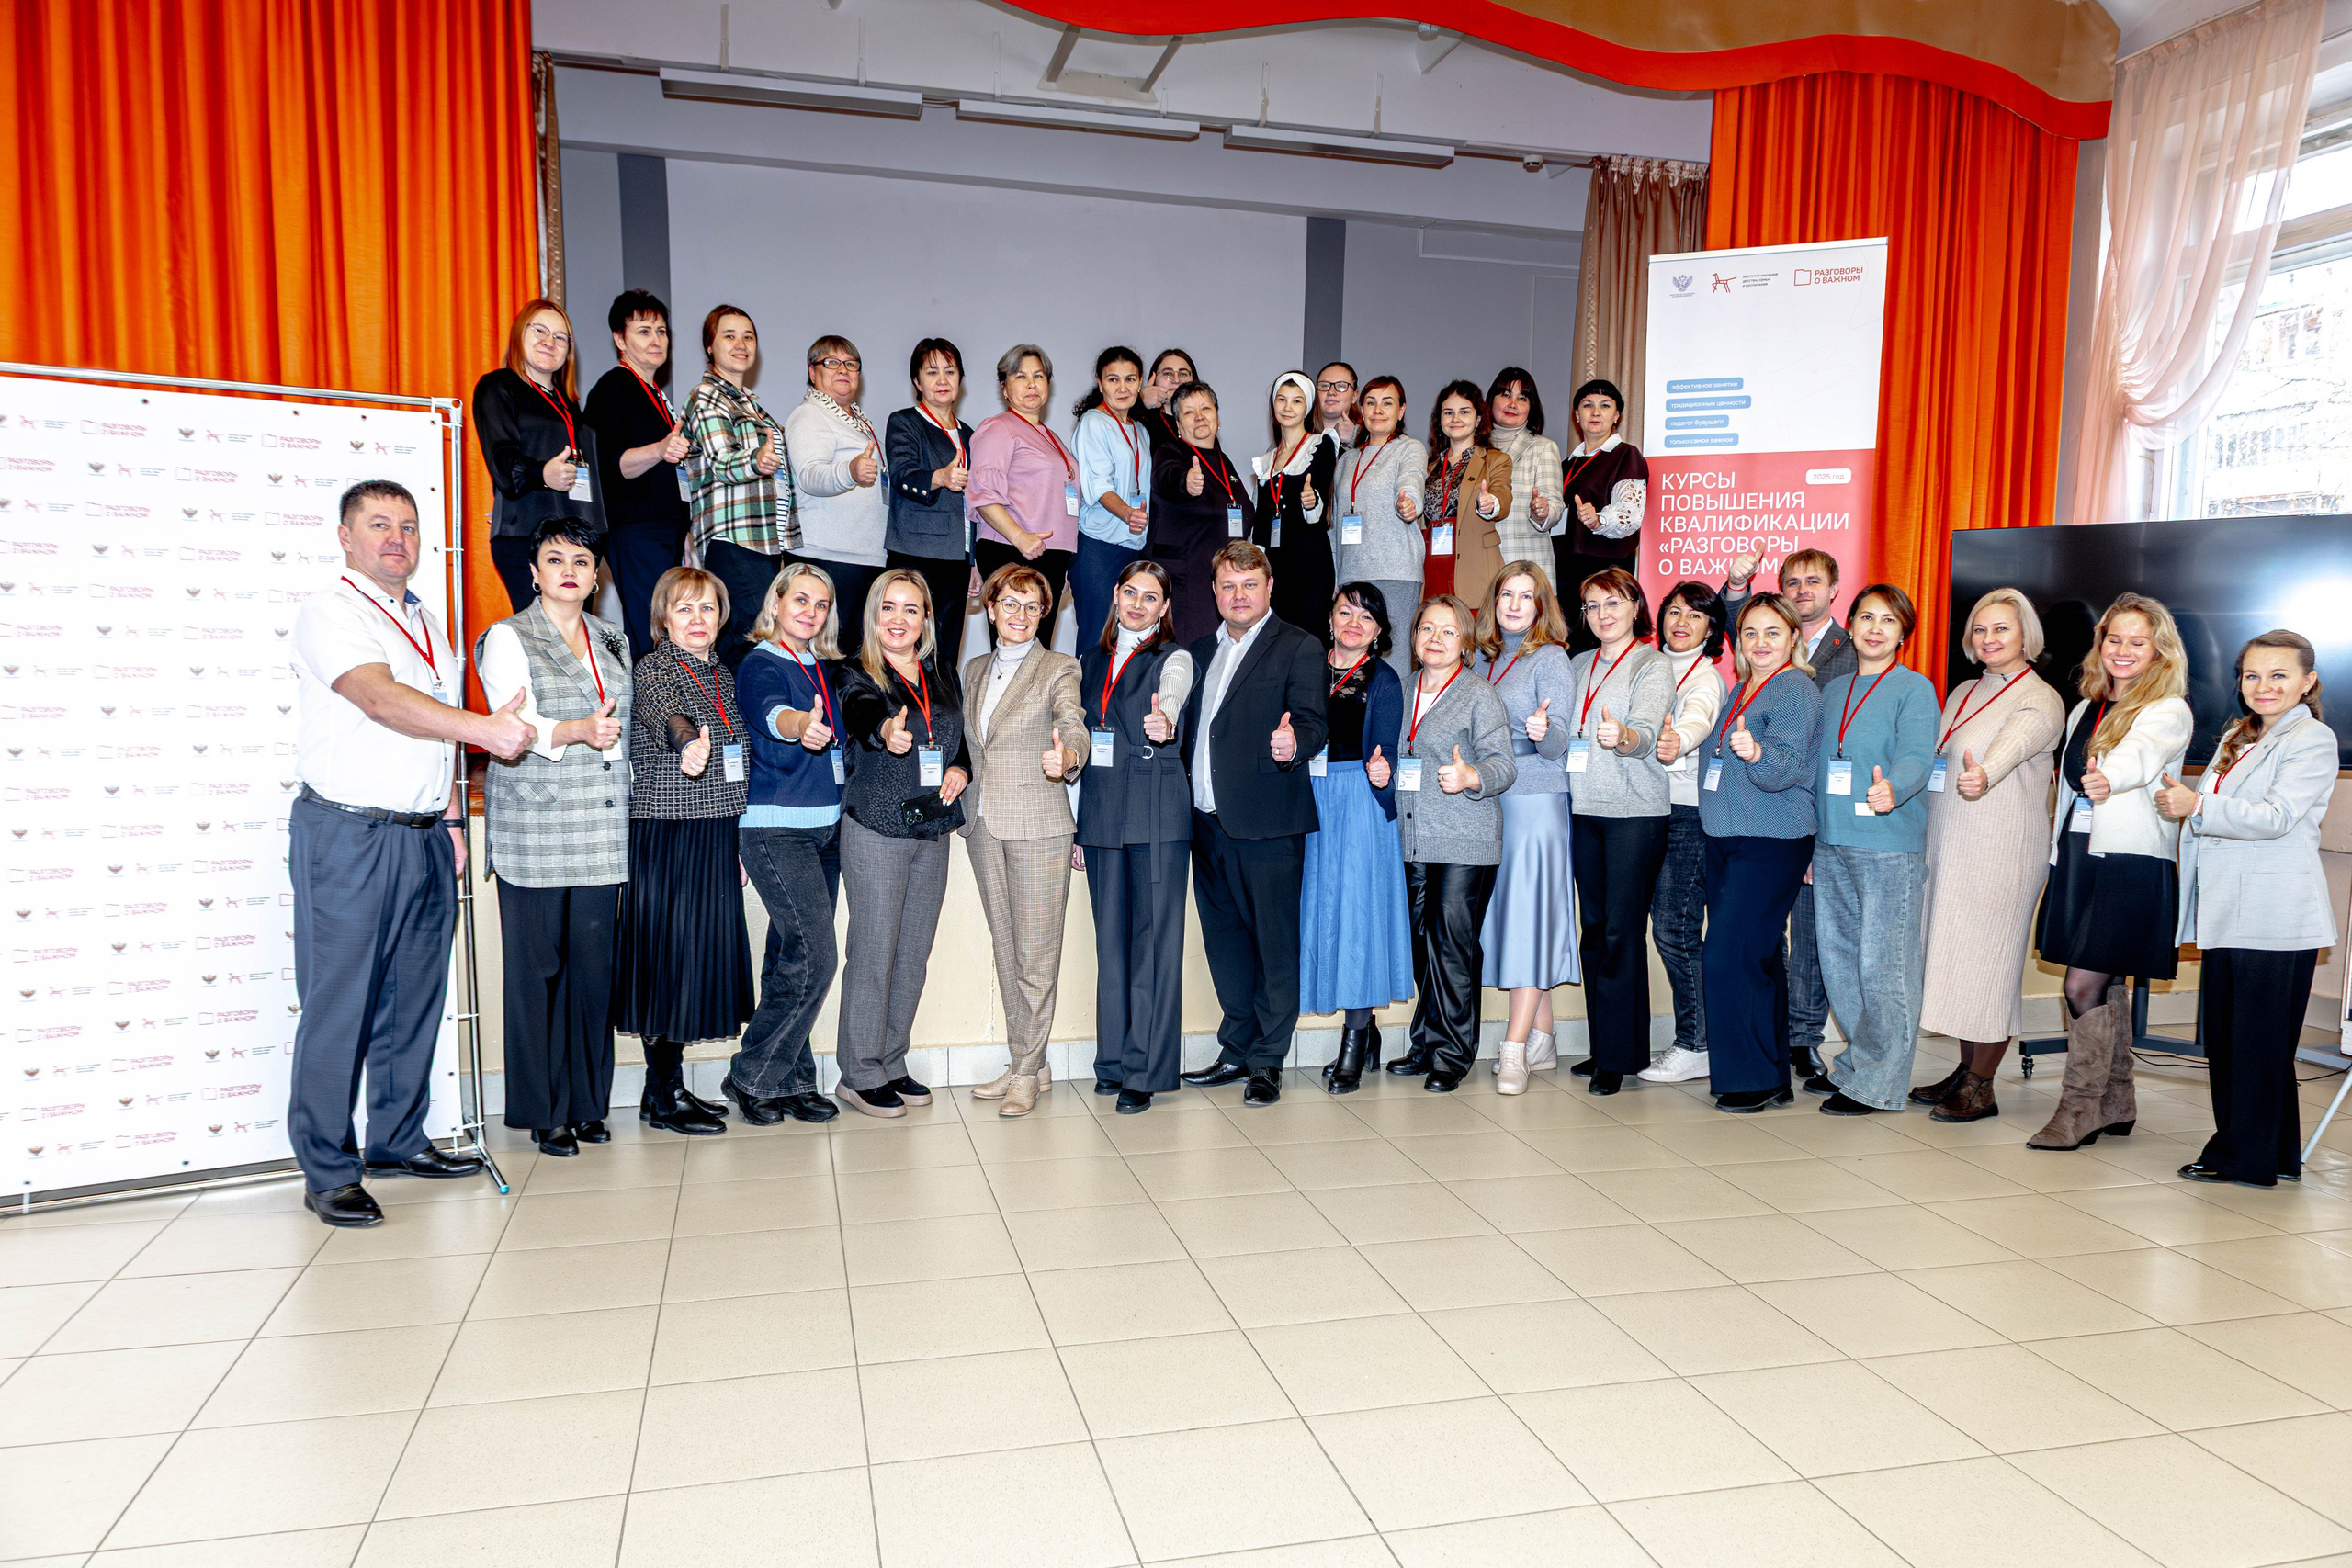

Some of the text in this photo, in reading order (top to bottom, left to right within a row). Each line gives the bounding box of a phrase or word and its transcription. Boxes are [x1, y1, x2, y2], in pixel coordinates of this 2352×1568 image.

[1815, 266, 1863, 276] РАЗГОВОРЫ
[1822, 275, 1860, 283] ВАЖНОМ
[1662, 472, 1736, 490] КУРСЫ
[1661, 491, 1805, 511] ПОВЫШЕНИЯ
[1660, 513, 1849, 533] КВАЛИФИКАЦИИ
[1658, 536, 1799, 554] «РАЗГОВОРЫ
[1658, 559, 1673, 575] О
